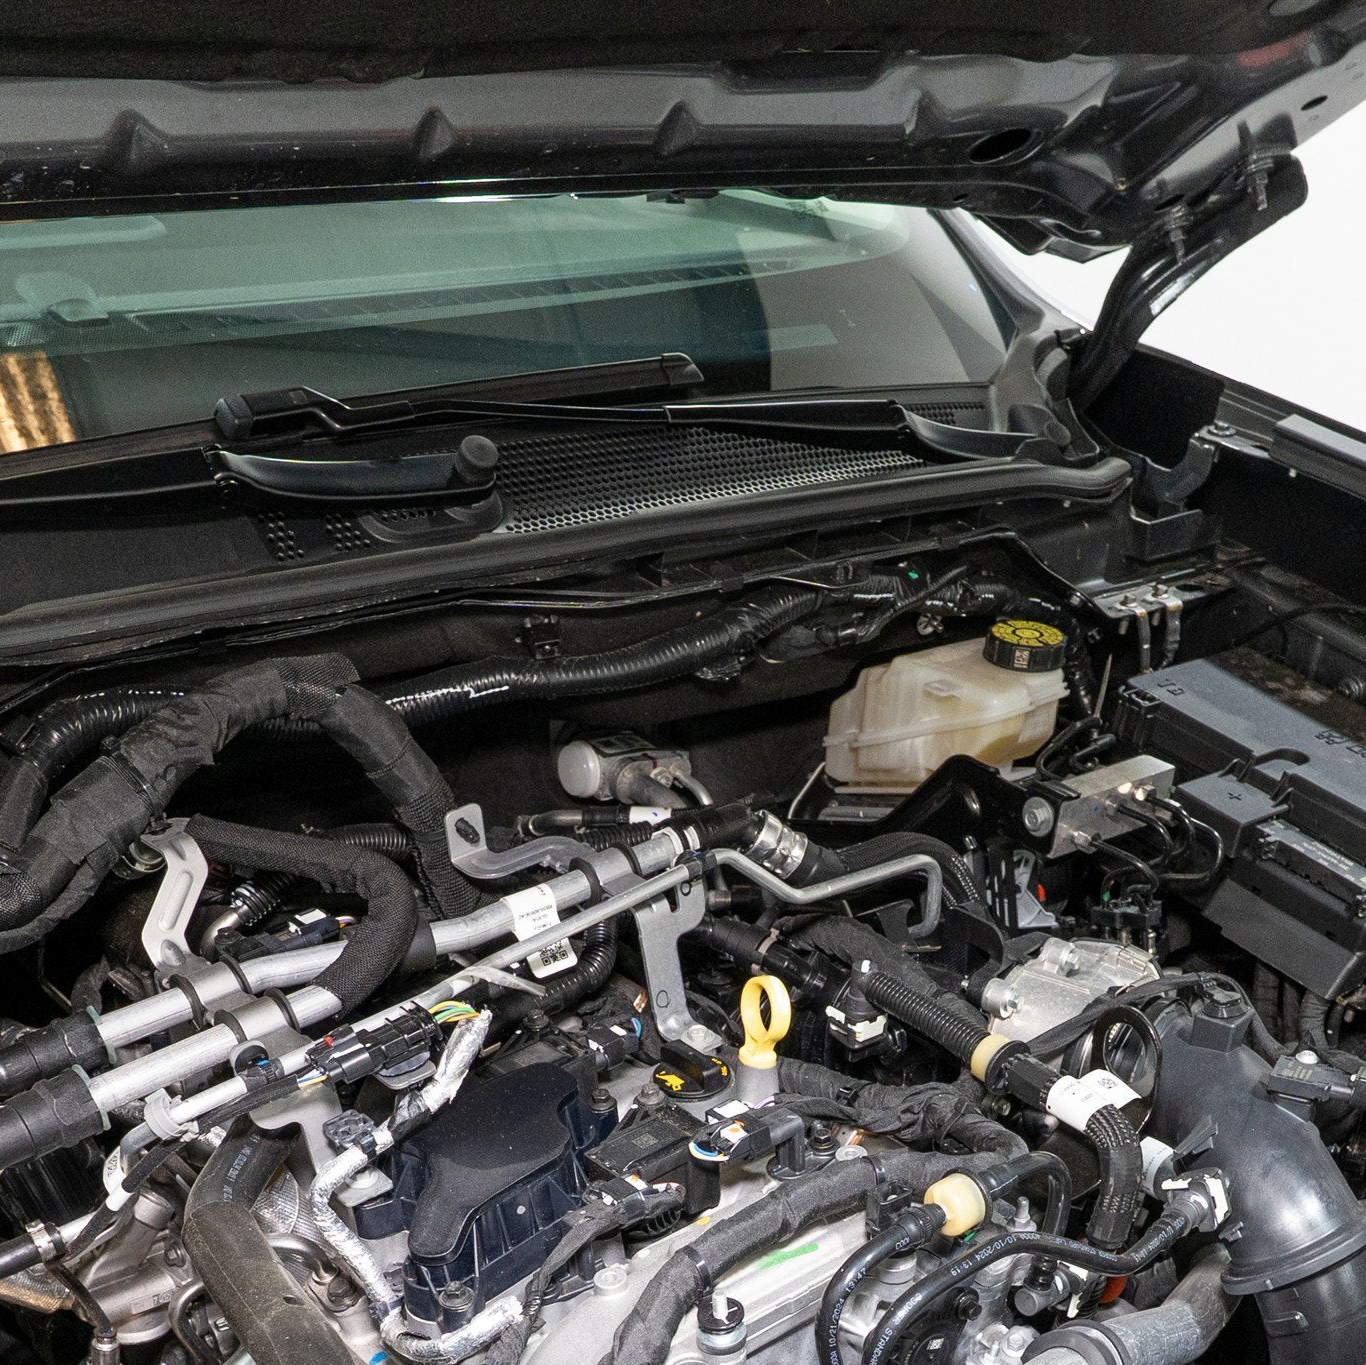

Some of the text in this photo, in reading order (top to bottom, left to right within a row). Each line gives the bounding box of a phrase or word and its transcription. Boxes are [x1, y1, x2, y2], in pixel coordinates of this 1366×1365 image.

[975, 1234, 1017, 1262] 10/10/2024
[828, 1298, 845, 1348] 10/21/2024
[845, 1267, 867, 1293] 13:47
